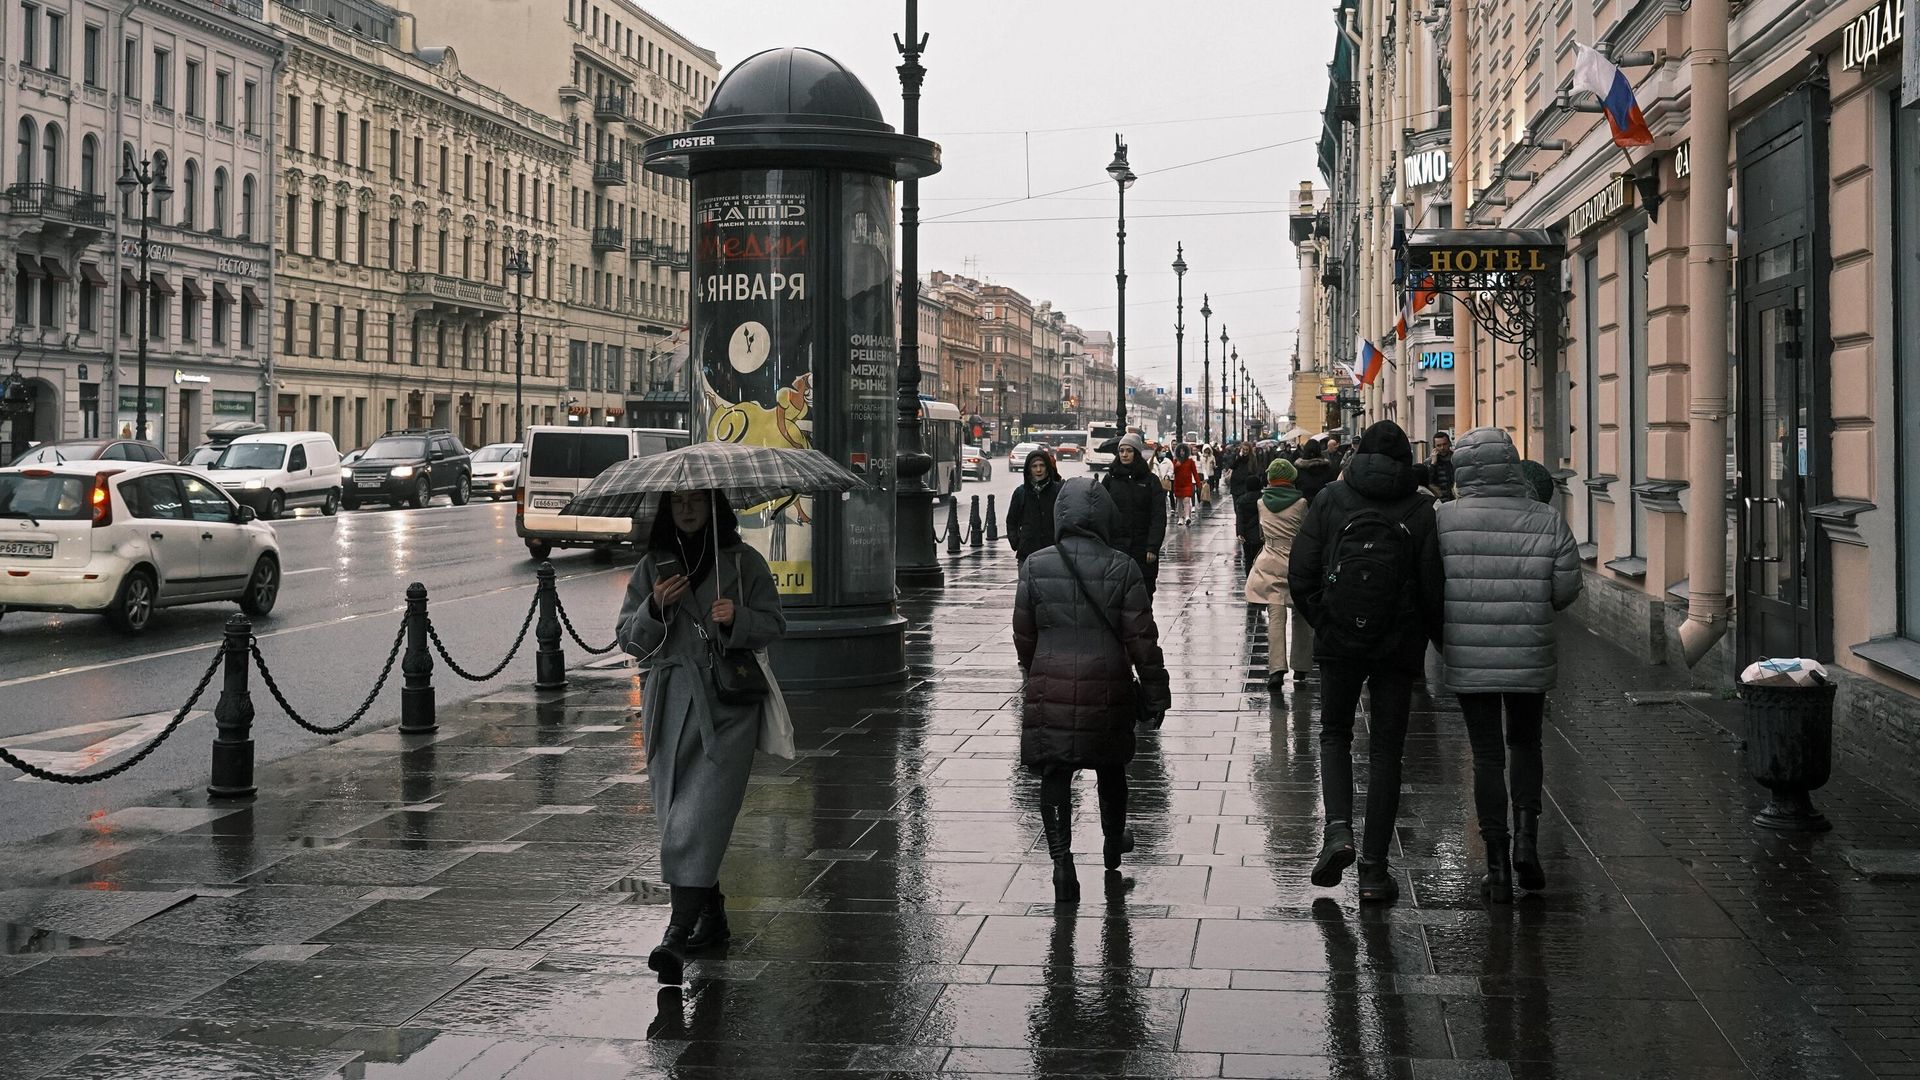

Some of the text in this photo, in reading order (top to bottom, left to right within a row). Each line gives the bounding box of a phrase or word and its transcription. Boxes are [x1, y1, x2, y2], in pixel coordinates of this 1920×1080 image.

[672, 136, 715, 148] POSTER
[1675, 143, 1690, 178] ФА
[1568, 176, 1624, 239] ИМПЕРАТОРСКИЙ
[218, 256, 261, 278] РЕСТОРАН
[1428, 249, 1546, 272] HOTEL
[707, 272, 805, 302] ЯНВАРЯ
[1423, 351, 1454, 369] РИВ
[850, 378, 887, 391] РЫНКЕ
